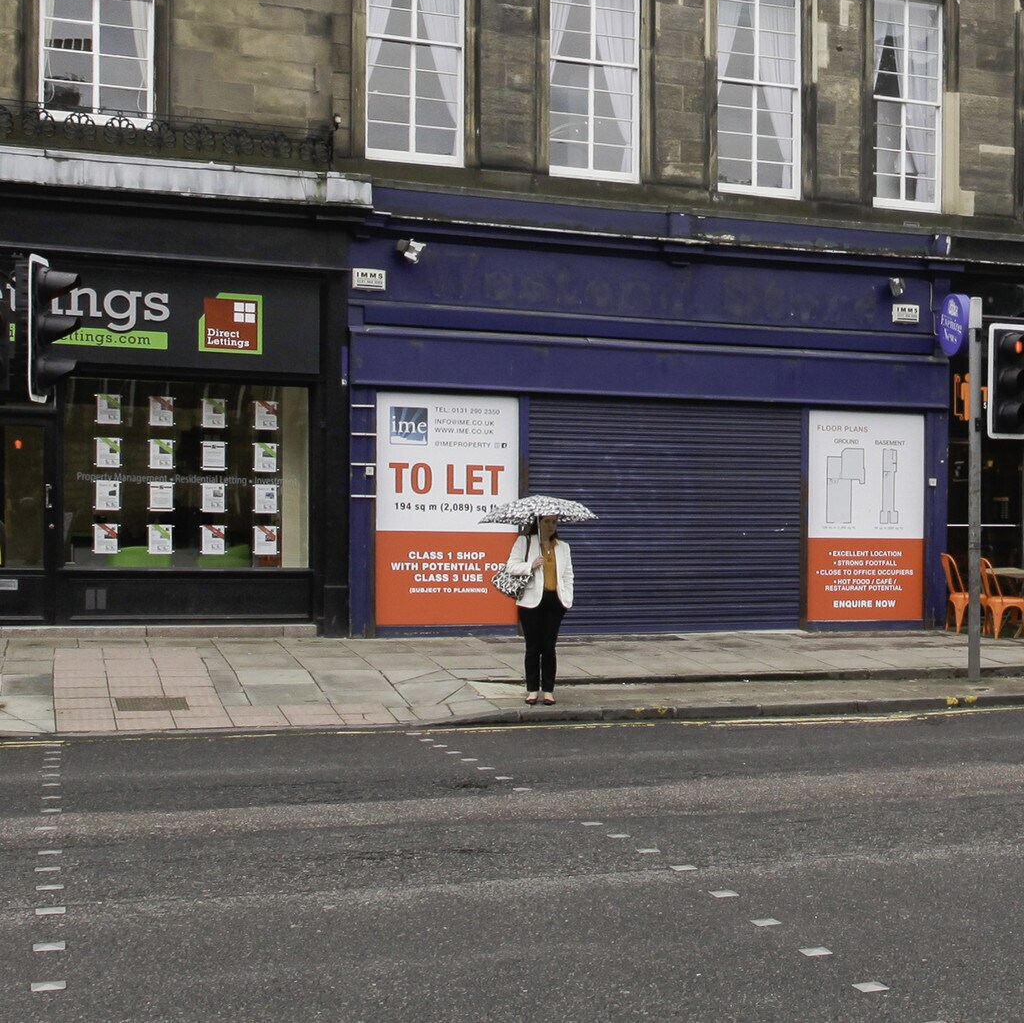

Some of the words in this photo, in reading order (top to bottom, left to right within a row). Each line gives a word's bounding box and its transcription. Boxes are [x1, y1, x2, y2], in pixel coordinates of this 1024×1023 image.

[356, 271, 383, 280] IMMS
[207, 328, 240, 338] Direct
[207, 337, 250, 348] Lettings
[391, 415, 427, 434] ime
[76, 472, 110, 482] Property
[114, 472, 167, 483] Management
[174, 474, 218, 484] Residential
[219, 475, 246, 485] Letting
[389, 462, 432, 494] TO
[446, 464, 505, 495] LET
[395, 502, 411, 510] 194
[440, 503, 473, 513] (2,089)
[476, 505, 487, 513] sq
[408, 551, 443, 559] CLASS
[456, 552, 486, 560] SHOP
[391, 562, 418, 570] WITH
[422, 562, 481, 571] POTENTIAL
[414, 574, 449, 582] CLASS
[452, 574, 459, 582] 3
[462, 574, 483, 582] USE
[833, 600, 872, 608] ENQUIRE
[875, 600, 896, 608] NOW
